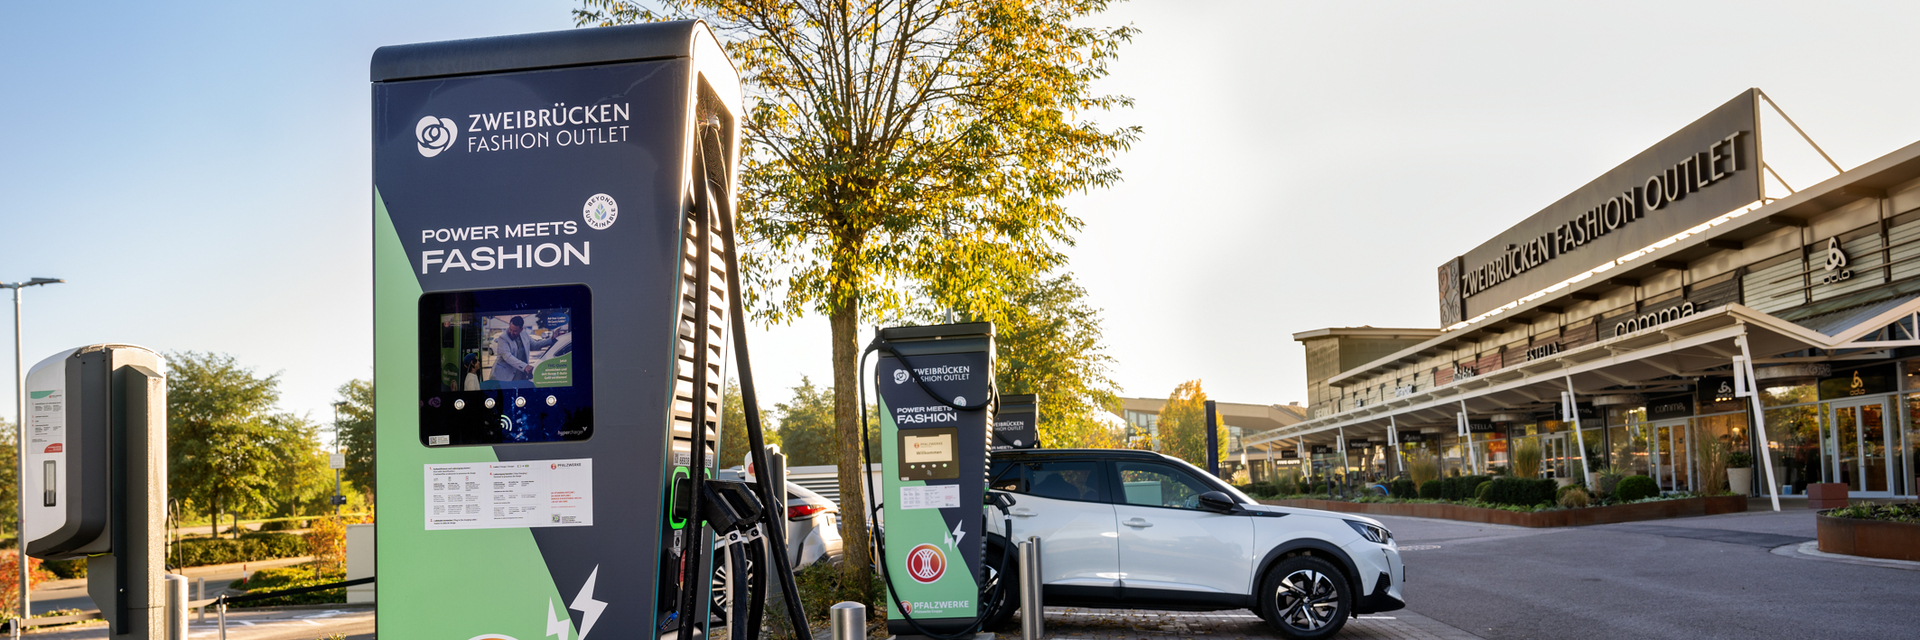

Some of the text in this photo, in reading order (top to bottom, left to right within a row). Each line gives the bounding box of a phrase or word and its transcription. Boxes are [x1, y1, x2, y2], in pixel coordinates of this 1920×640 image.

[468, 102, 630, 132] ZWEIBRÜCKEN
[468, 125, 630, 153] FASHION OUTLET
[587, 195, 614, 207] BEYOND
[585, 207, 616, 228] SUSTAINABLE
[1462, 131, 1742, 299] ZWEIBRÜCKEN FASHION OUTLET
[421, 220, 578, 243] POWER MEETS
[421, 241, 591, 274] FASHION
[1822, 269, 1851, 285] odlo
[1525, 341, 1560, 362] ESTELLA
[912, 373, 970, 383] SHION OUTLET
[1849, 387, 1866, 396] odlo
[896, 406, 926, 414] POWER
[1655, 402, 1686, 413] comma,
[897, 412, 958, 424] FASHION
[1469, 423, 1494, 431] STELLA
[913, 600, 969, 610] PFALZWERKE
